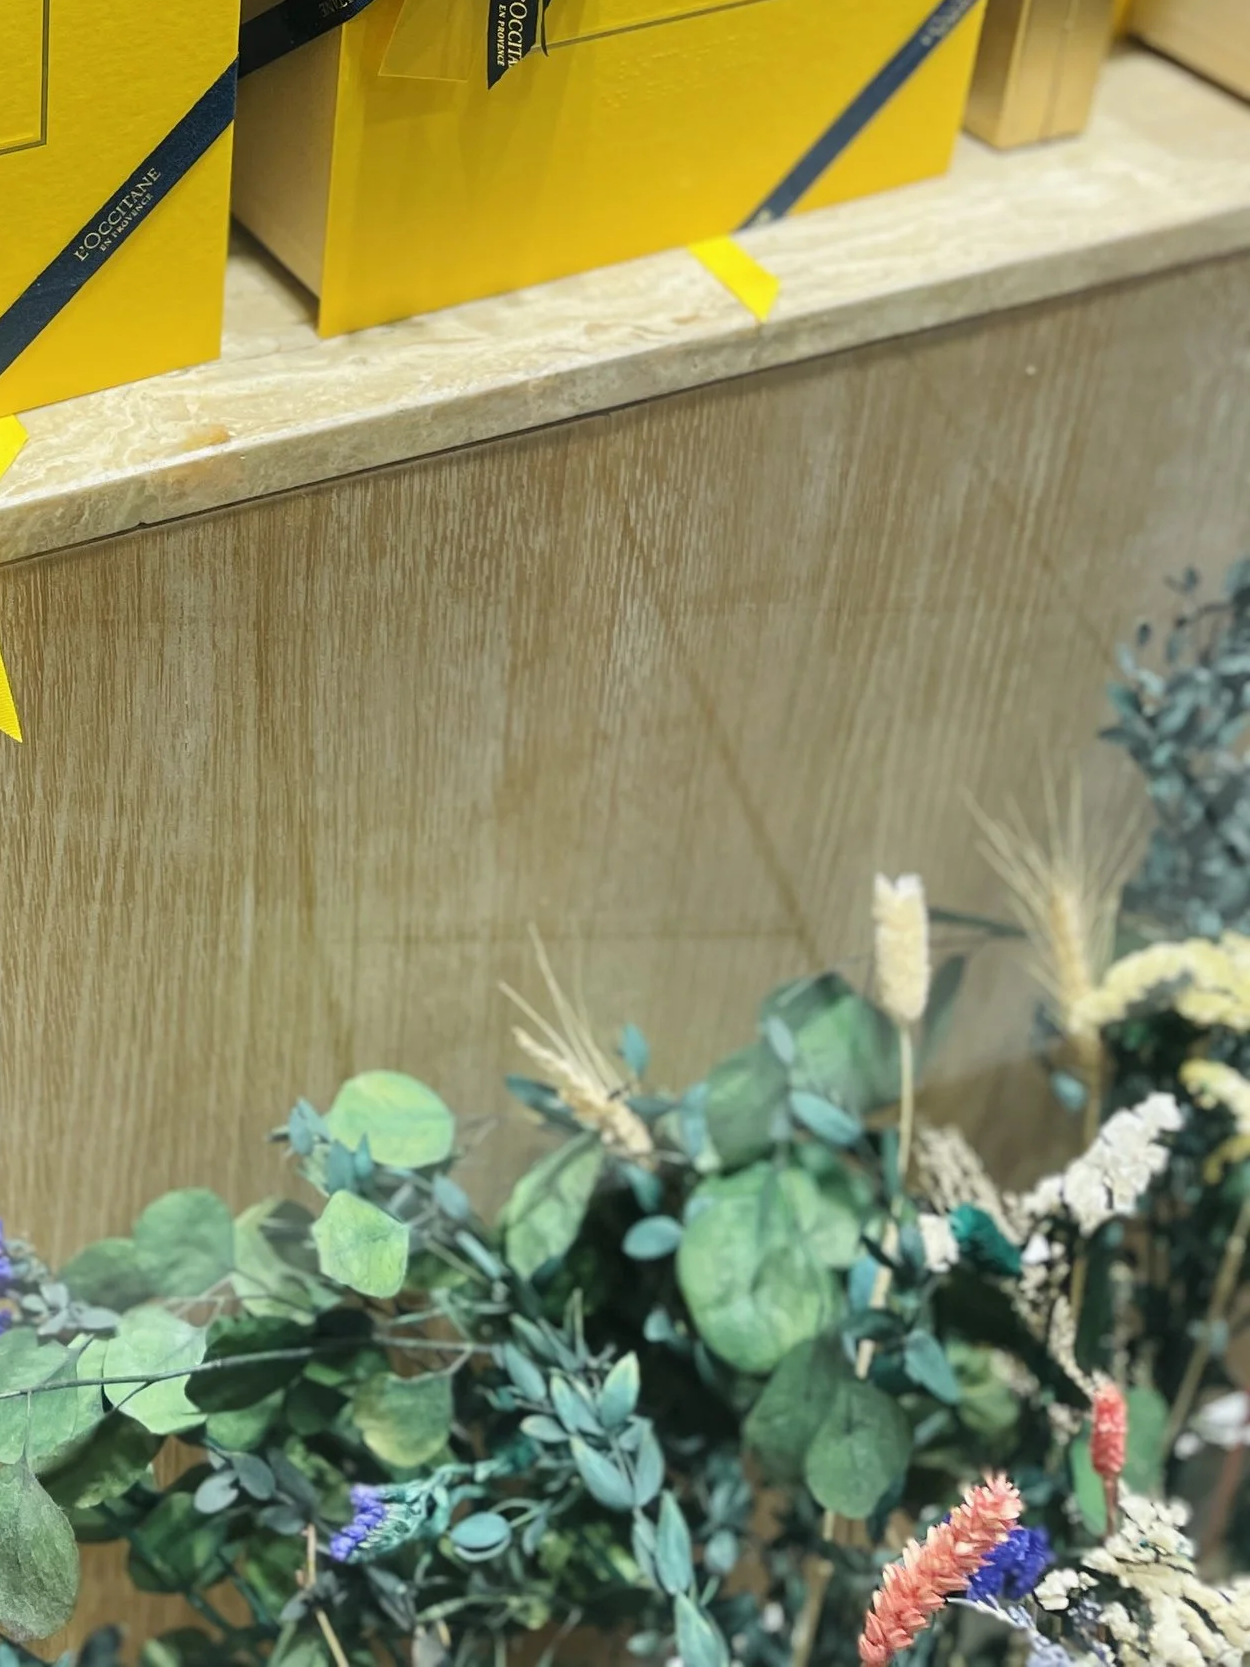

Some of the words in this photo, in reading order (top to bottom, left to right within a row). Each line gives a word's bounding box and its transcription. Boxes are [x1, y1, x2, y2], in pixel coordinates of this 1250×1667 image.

[499, 5, 506, 18] EN
[497, 20, 505, 66] PROVENCE
[74, 168, 161, 261] L'OCCITANE
[100, 238, 111, 251] EN
[112, 193, 153, 238] PROVENCE
